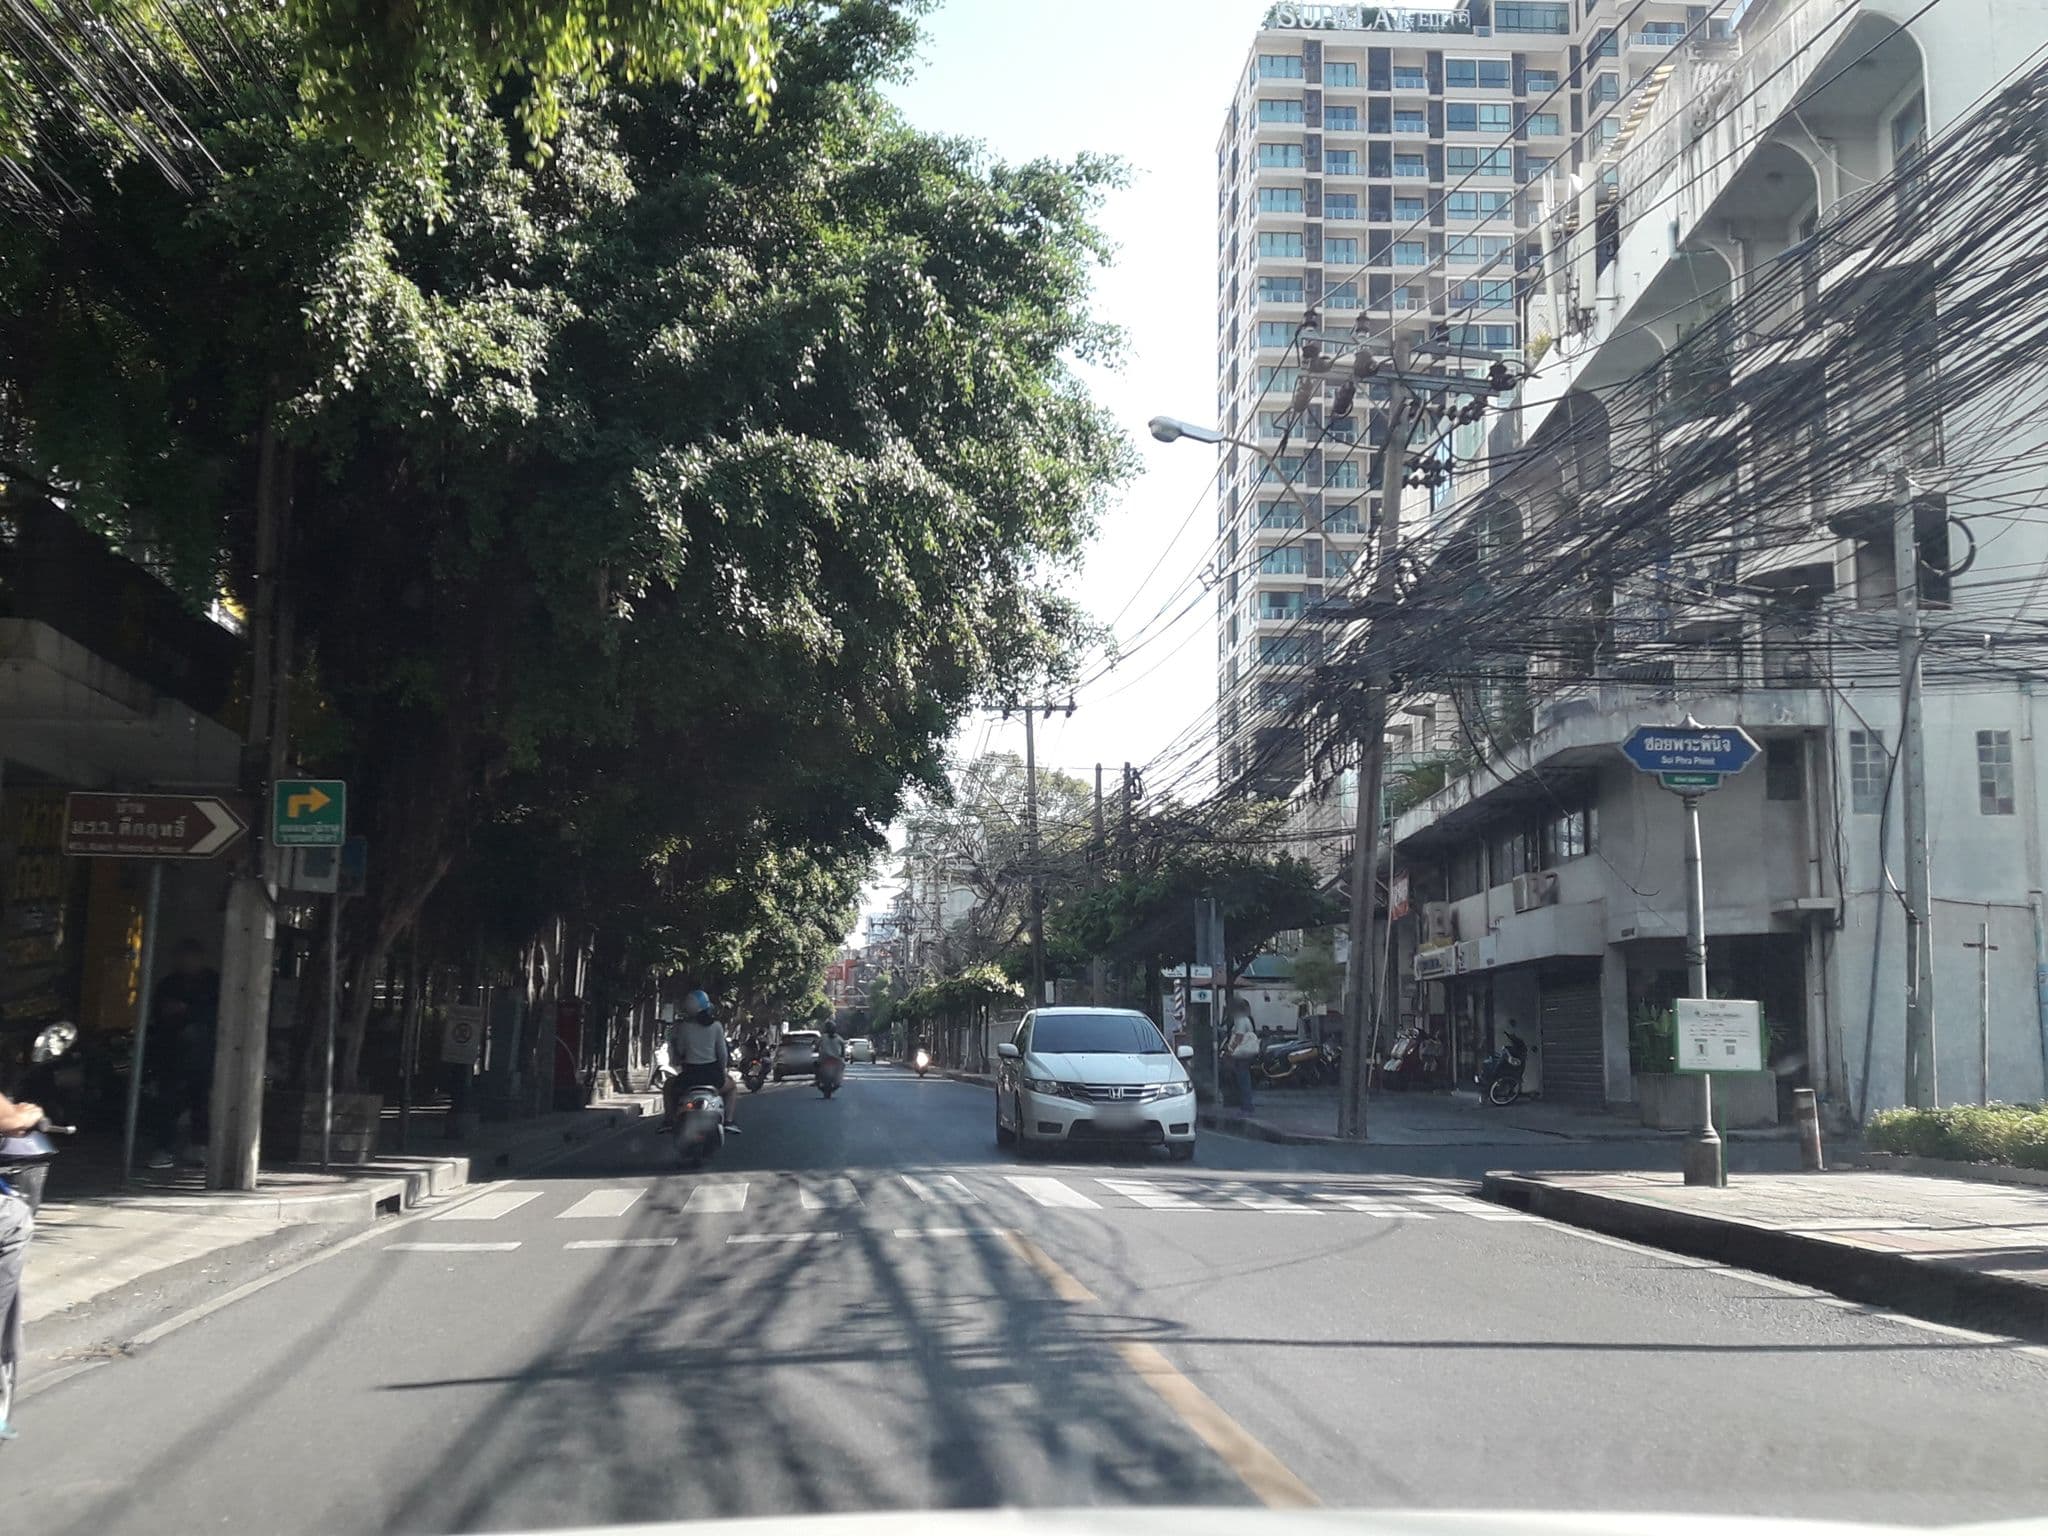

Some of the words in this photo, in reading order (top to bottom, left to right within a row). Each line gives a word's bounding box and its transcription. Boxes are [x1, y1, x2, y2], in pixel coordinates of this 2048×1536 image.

[1643, 735, 1732, 752] ซอยพระพินิจ
